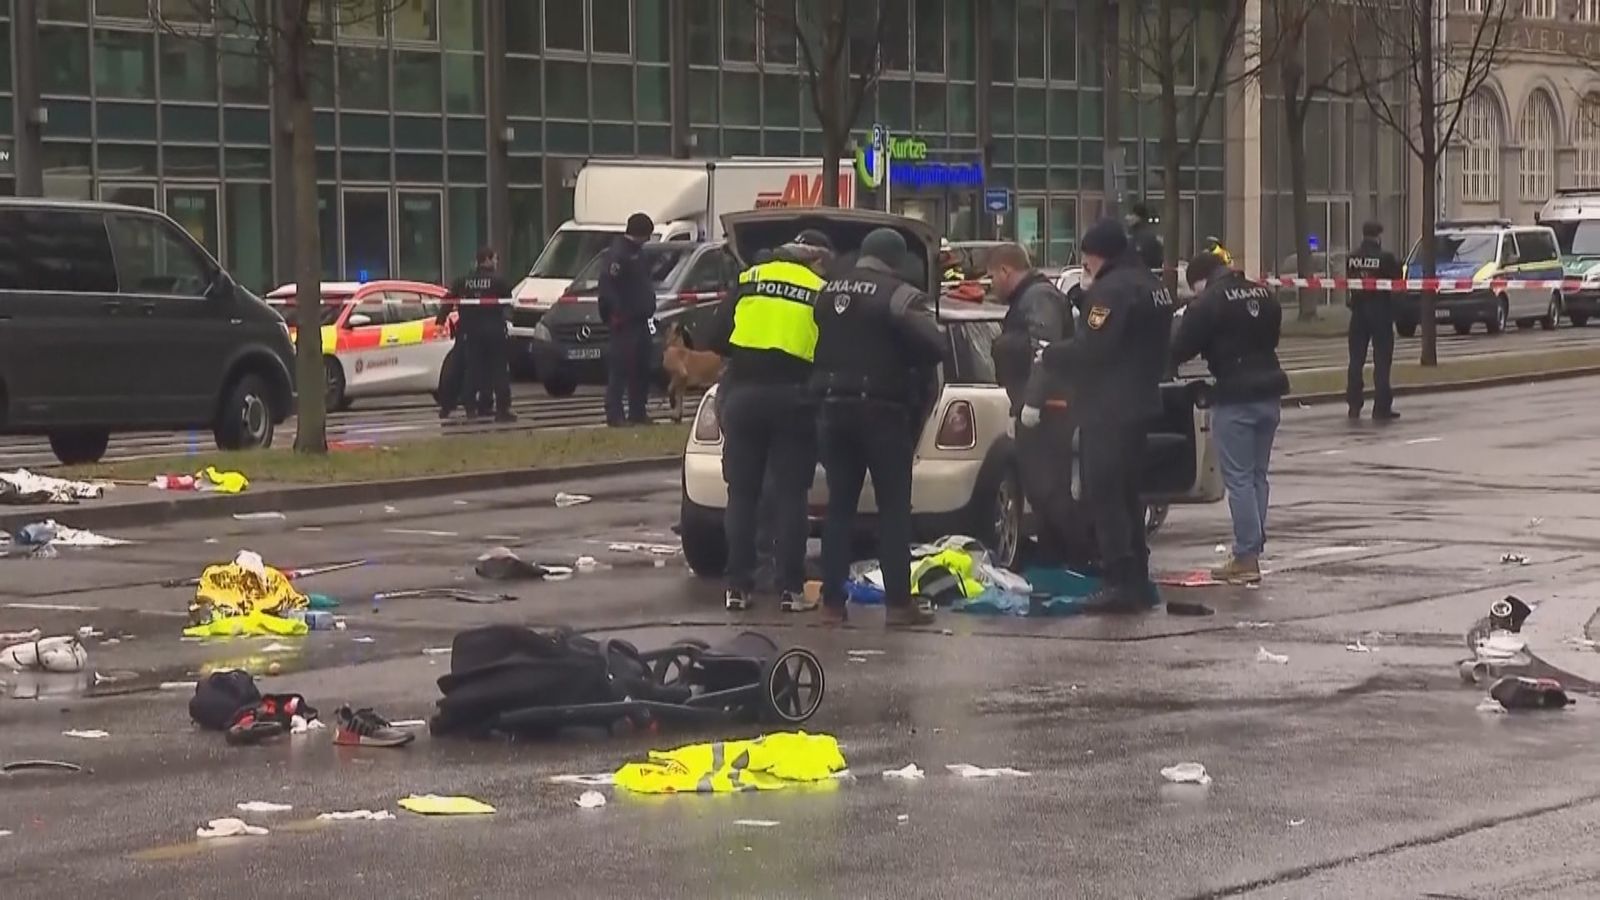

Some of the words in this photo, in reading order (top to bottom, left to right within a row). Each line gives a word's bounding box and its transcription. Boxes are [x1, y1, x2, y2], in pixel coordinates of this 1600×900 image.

[889, 137, 927, 159] Kurtze
[1349, 257, 1380, 268] POLIZEI
[465, 278, 491, 289] POLIZEI
[826, 280, 877, 295] LKA-KTI
[757, 282, 811, 301] POLIZEI
[1225, 287, 1269, 300] LKA-KTI
